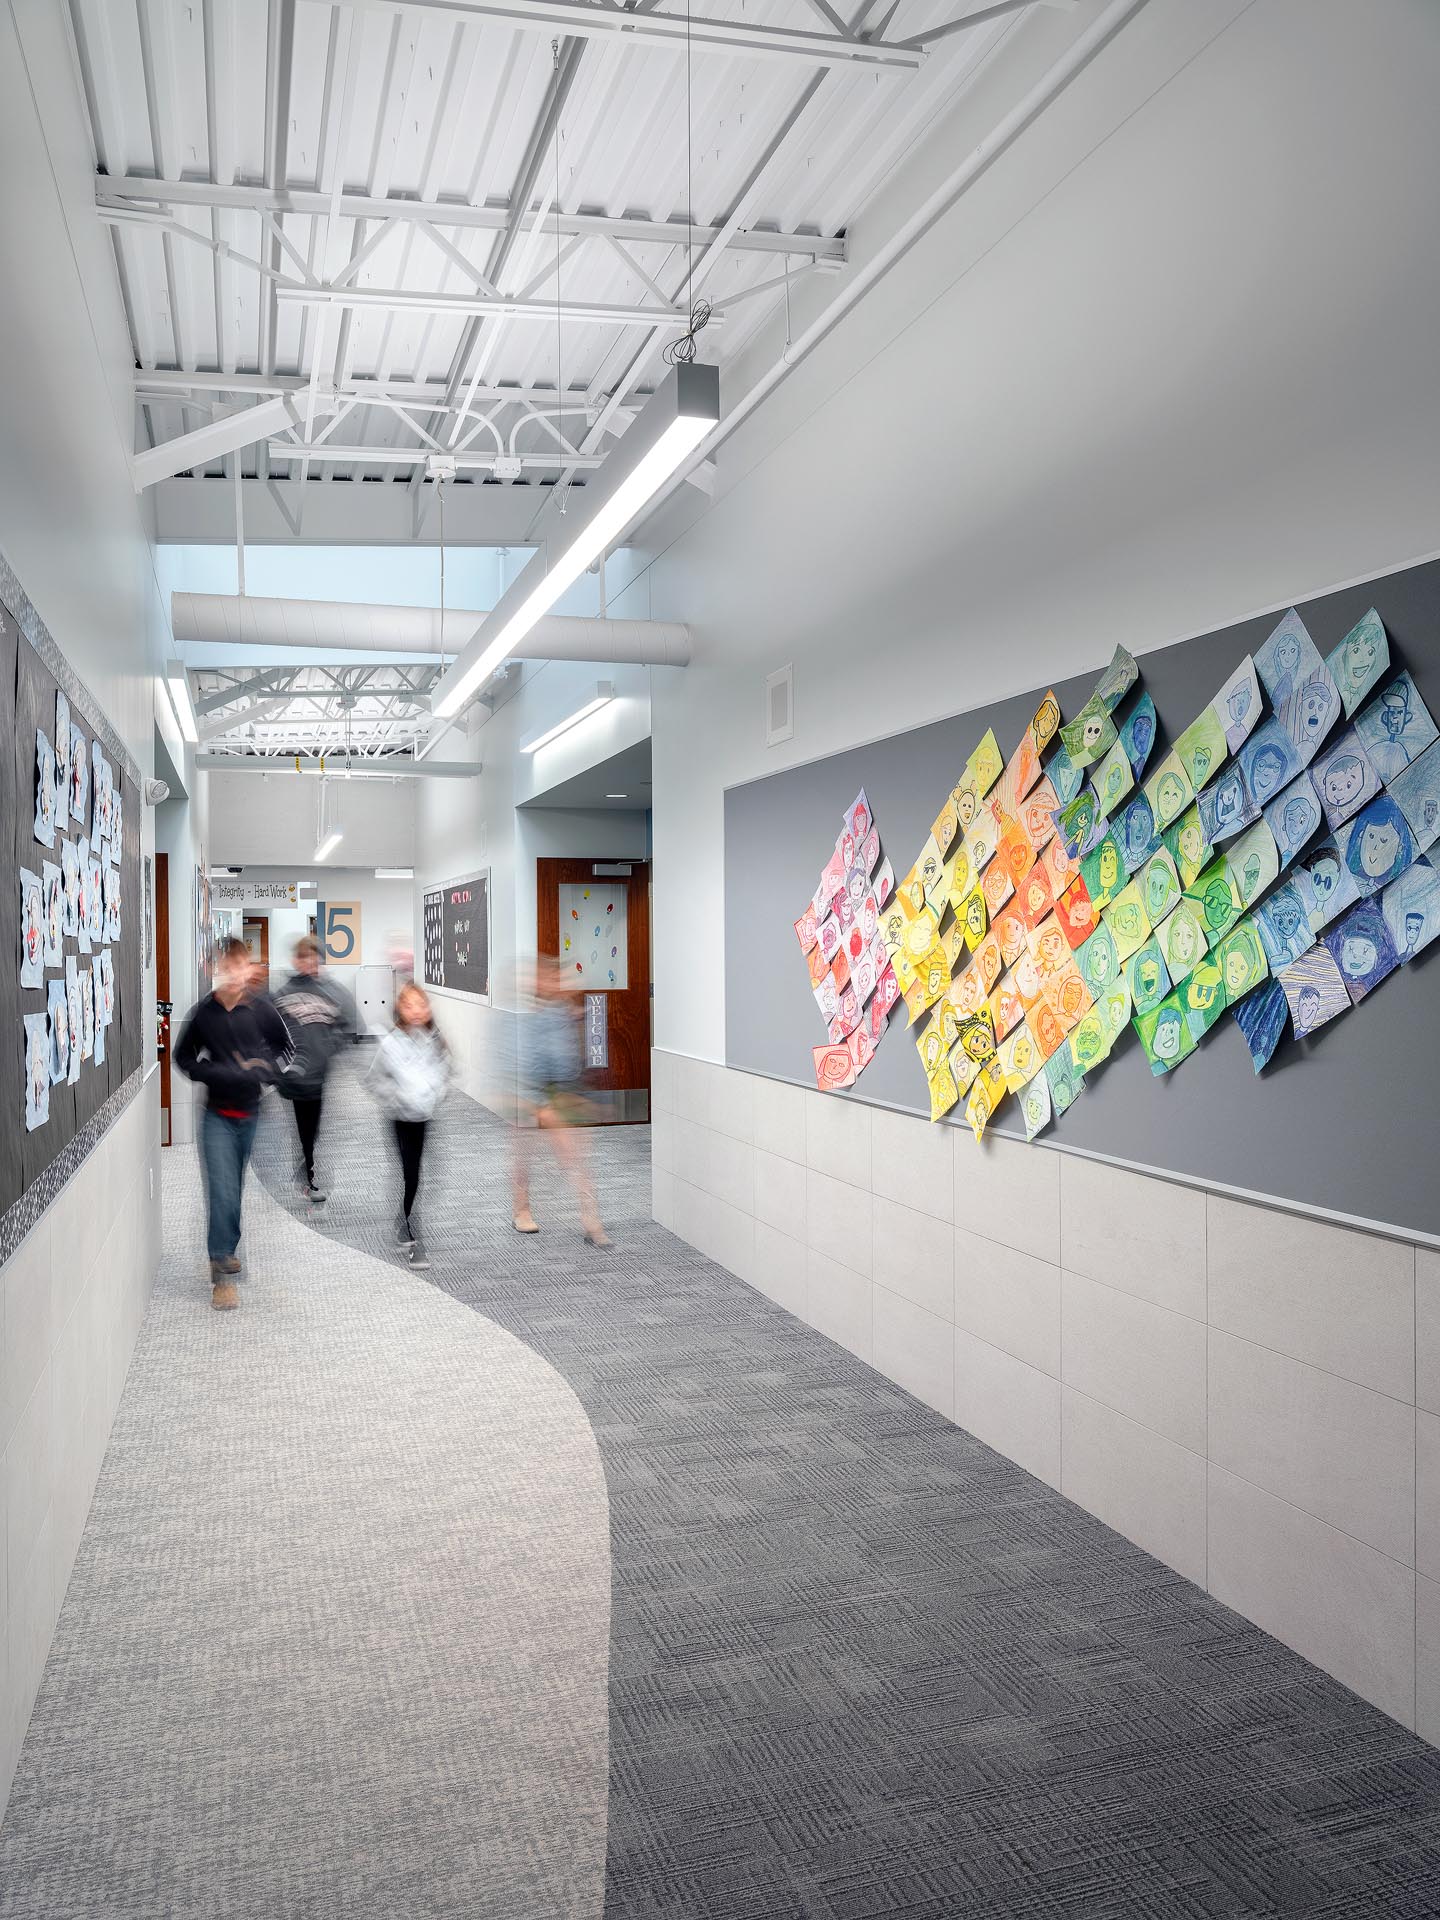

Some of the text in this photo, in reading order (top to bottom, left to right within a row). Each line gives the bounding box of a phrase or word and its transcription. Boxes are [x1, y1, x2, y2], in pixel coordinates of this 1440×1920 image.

[219, 884, 244, 901] Integrity
[254, 884, 269, 899] Hard
[269, 884, 287, 899] Work
[588, 995, 603, 1066] WELCOME
